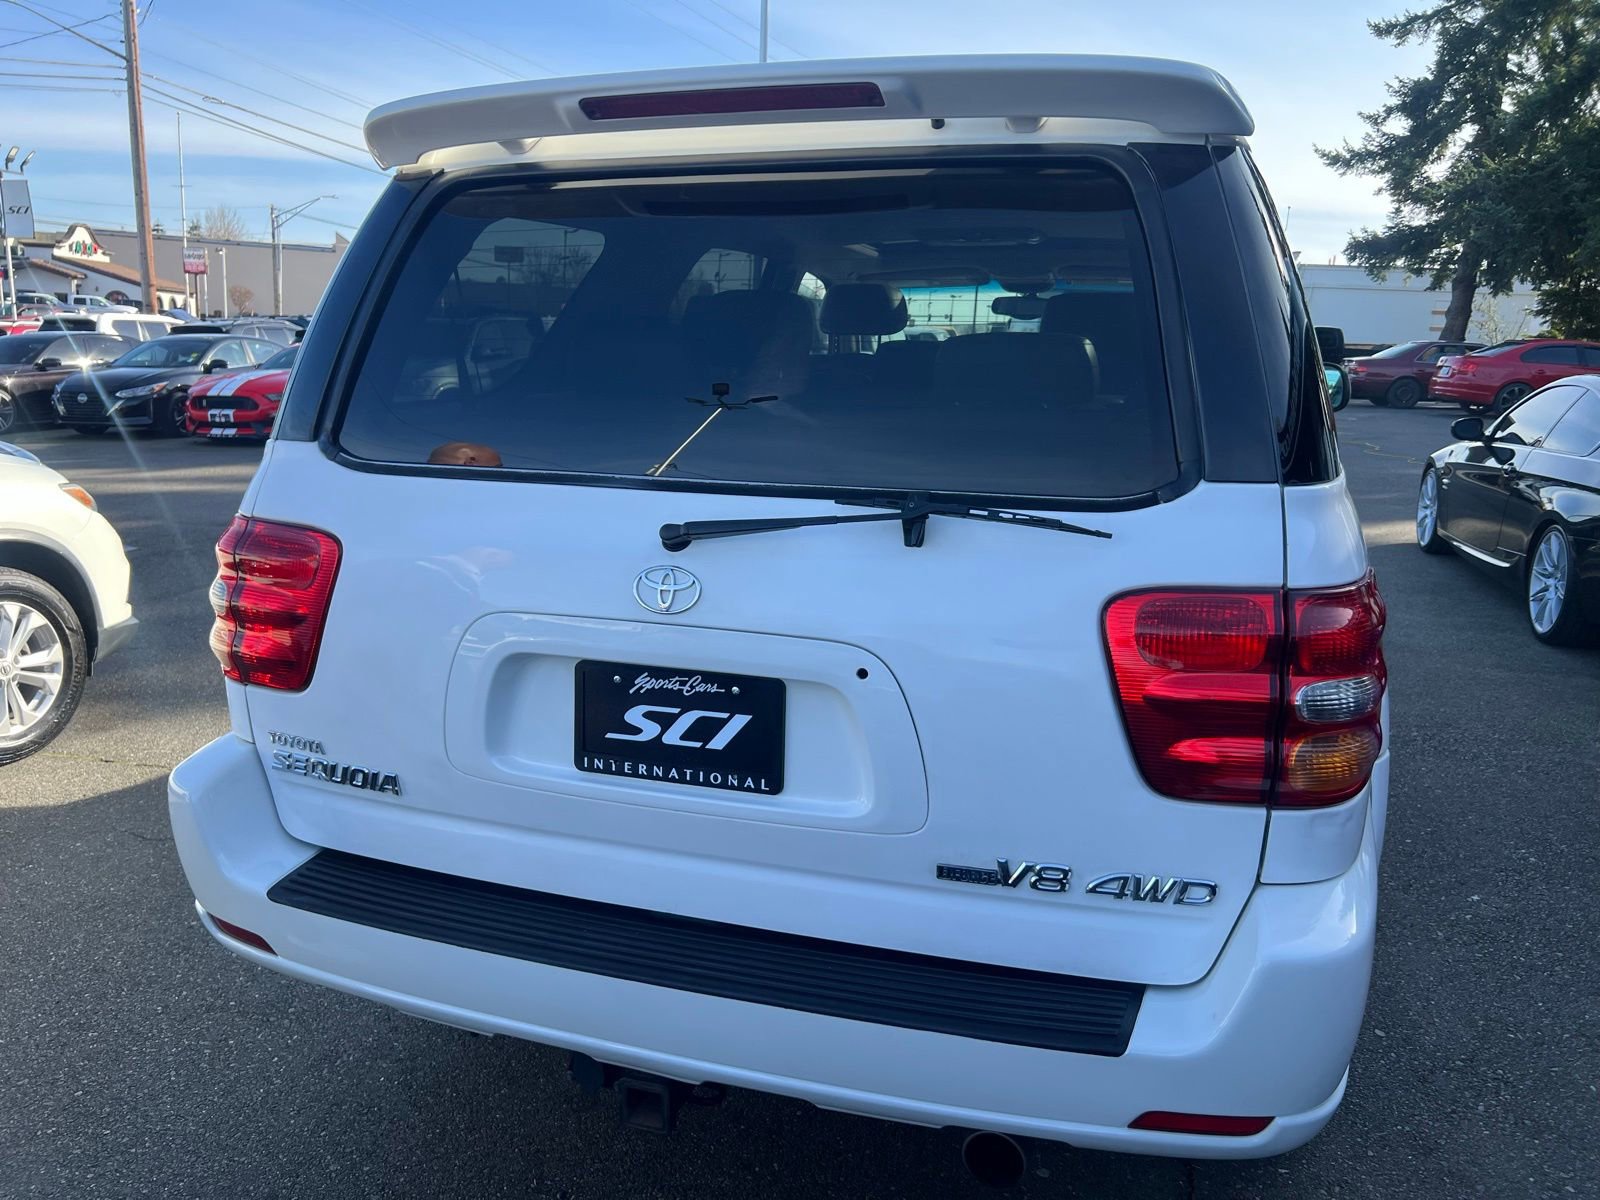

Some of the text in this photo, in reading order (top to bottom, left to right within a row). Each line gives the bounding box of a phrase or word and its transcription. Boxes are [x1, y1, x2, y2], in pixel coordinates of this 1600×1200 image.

[6, 205, 31, 215] SCI
[629, 672, 726, 696] Sports Cars
[268, 730, 326, 755] TOYOTA
[604, 704, 753, 750] SCI
[271, 749, 402, 796] SEQUOIA
[584, 756, 770, 791] INTERNATIONAL
[996, 857, 1072, 892] V8
[1086, 872, 1218, 905] 4WD
